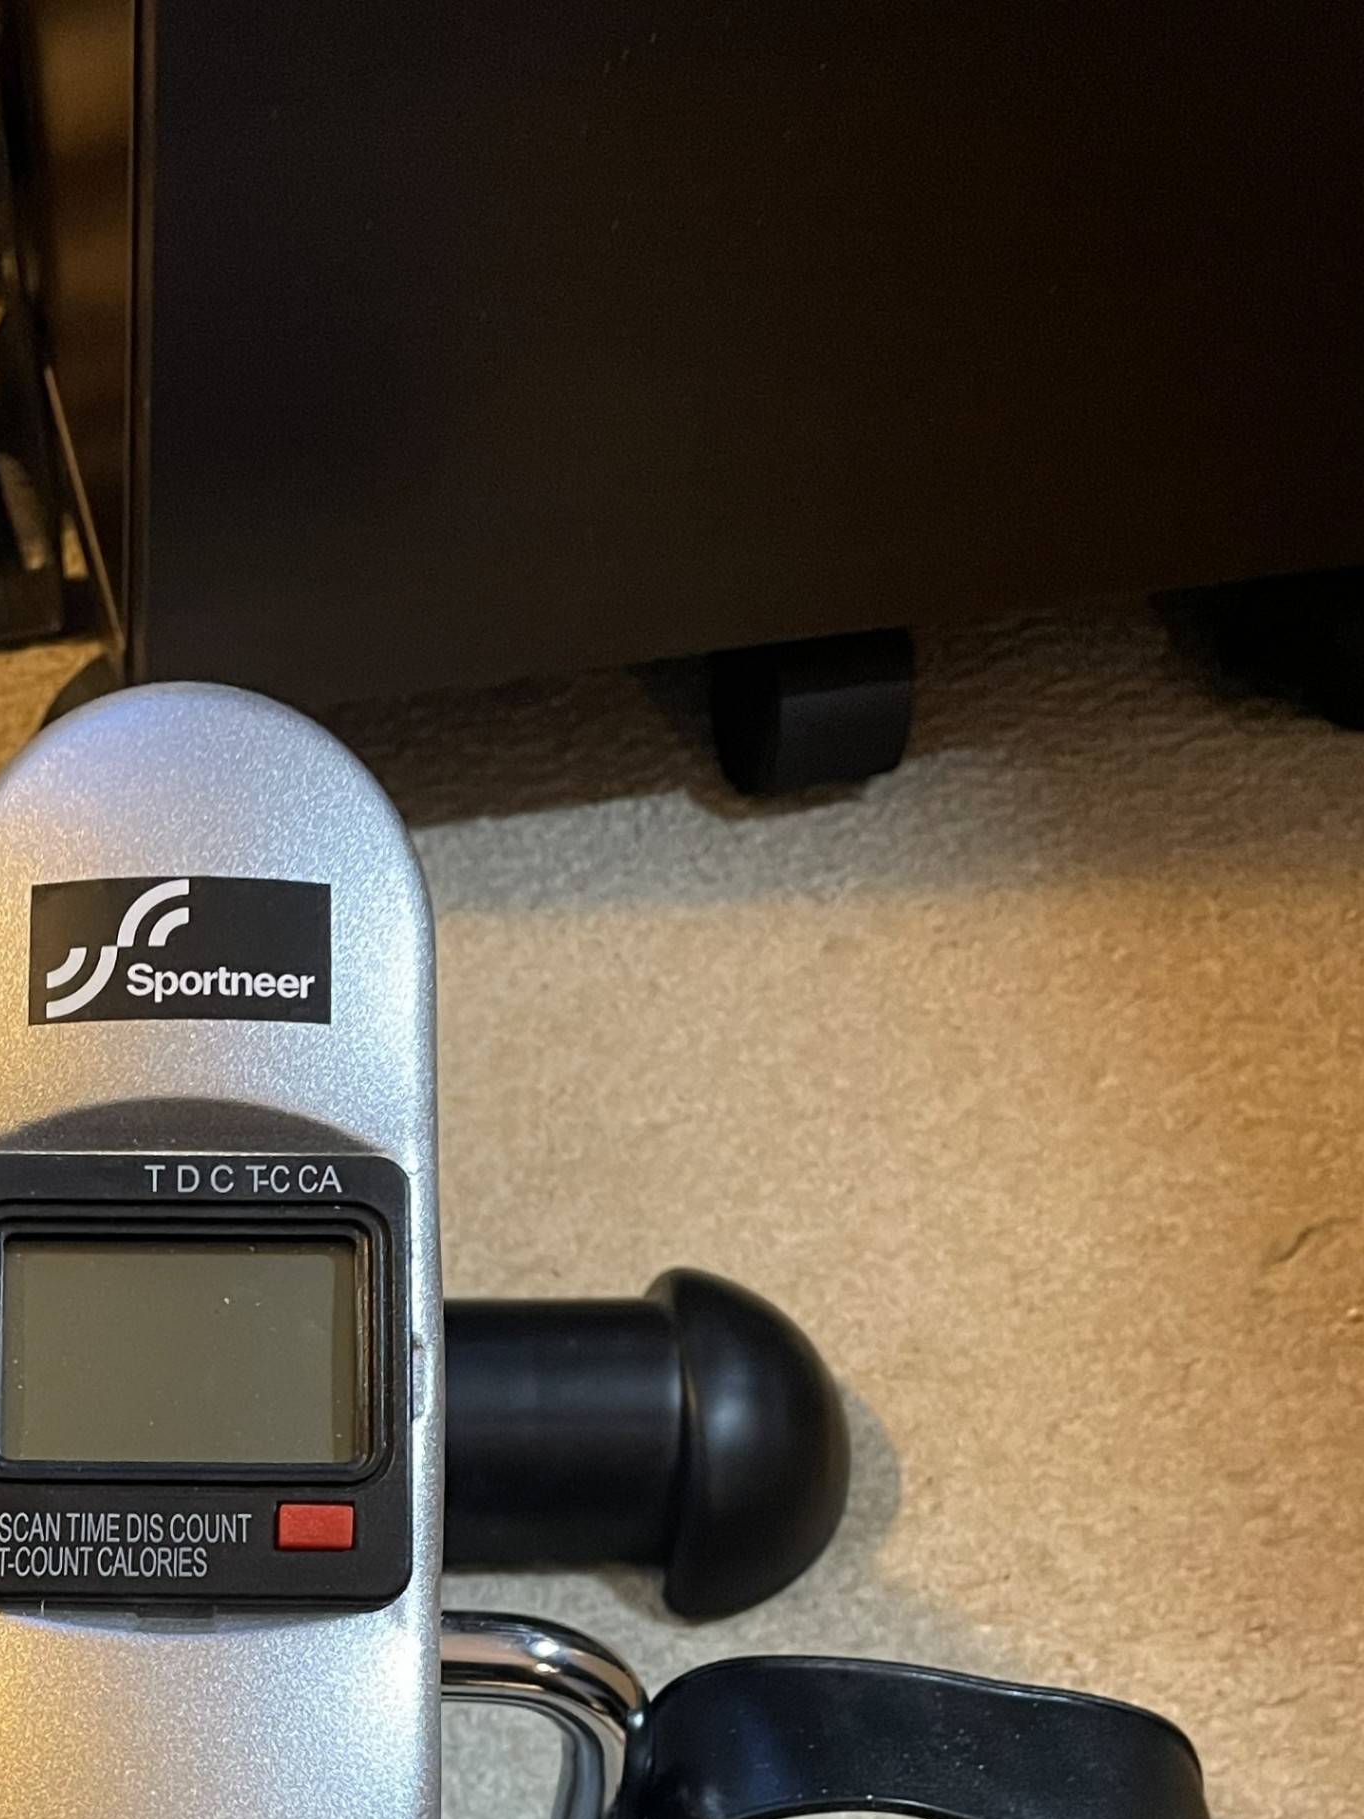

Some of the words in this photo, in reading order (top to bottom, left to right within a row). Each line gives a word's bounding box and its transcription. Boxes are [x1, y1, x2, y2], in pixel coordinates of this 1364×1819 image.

[126, 962, 316, 1003] Sportneer
[144, 1164, 166, 1193] T
[177, 1164, 200, 1193] D
[210, 1164, 235, 1194] C
[298, 1164, 343, 1194] CA
[66, 1512, 121, 1543] TIME
[126, 1513, 164, 1543] DIS
[169, 1513, 252, 1543] COUNT
[97, 1546, 208, 1578] CALORIES
